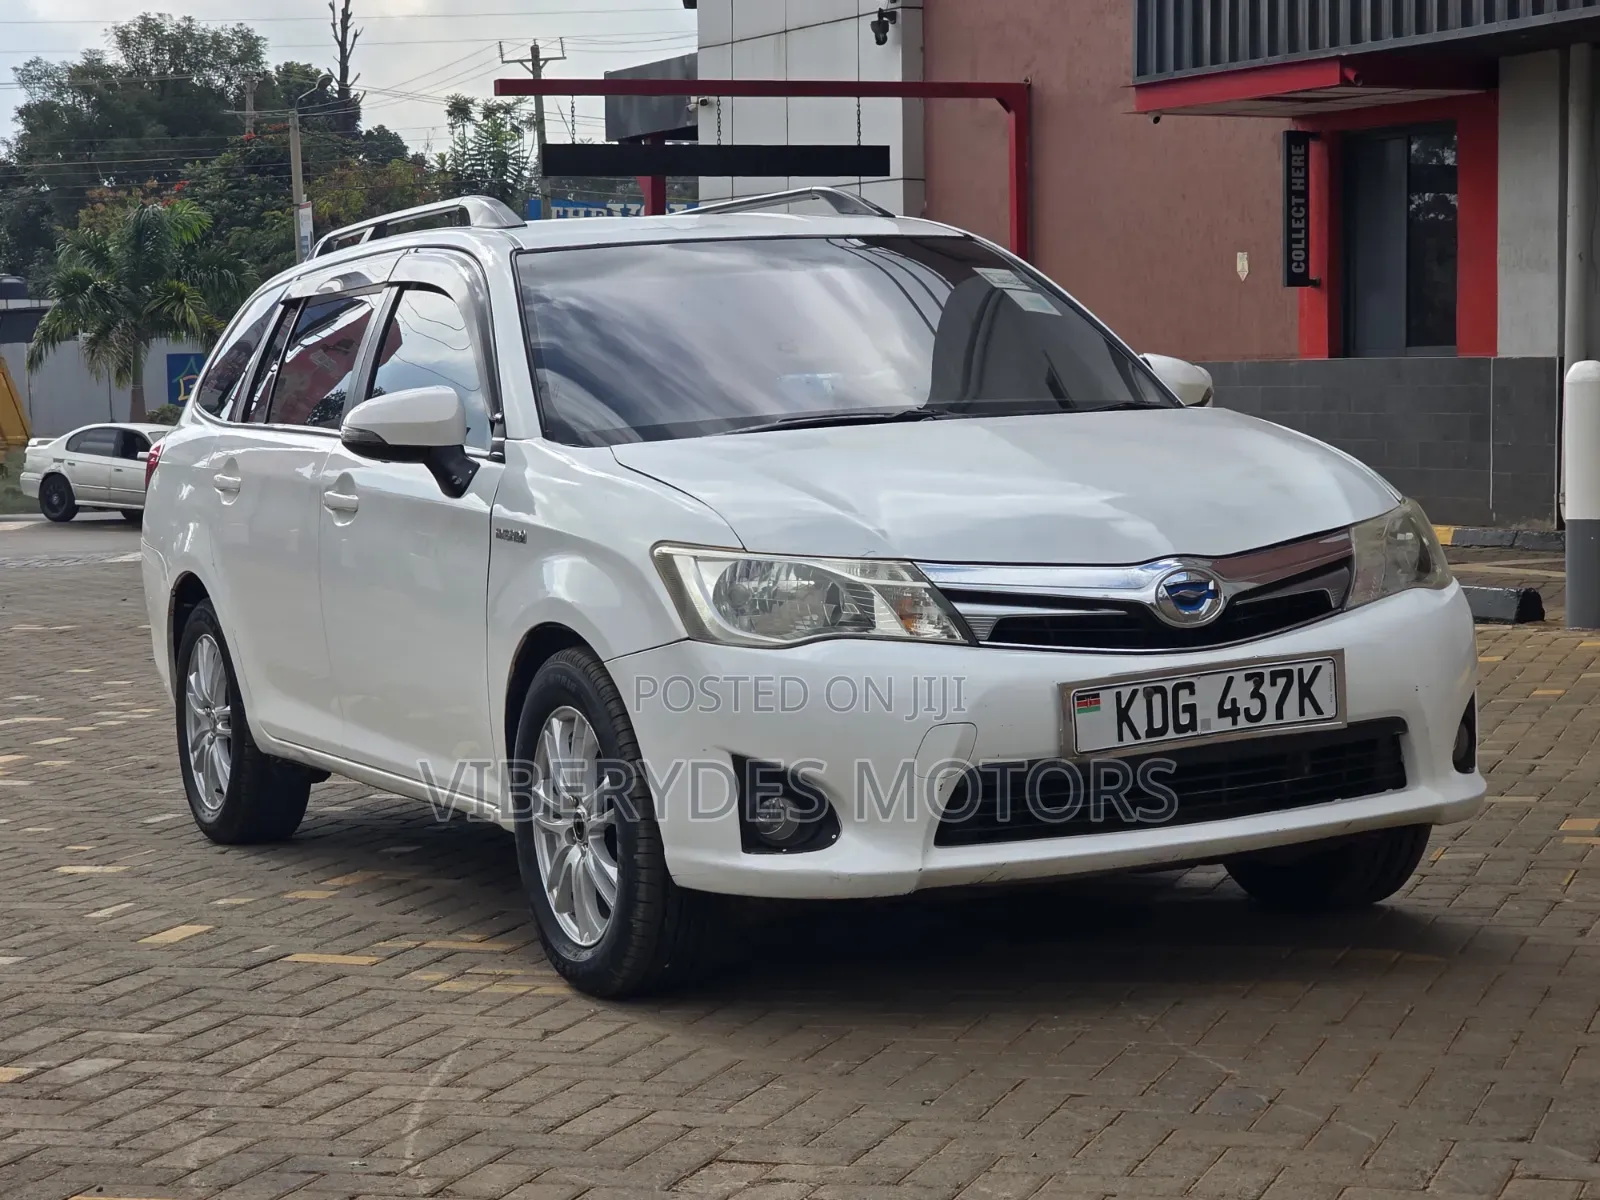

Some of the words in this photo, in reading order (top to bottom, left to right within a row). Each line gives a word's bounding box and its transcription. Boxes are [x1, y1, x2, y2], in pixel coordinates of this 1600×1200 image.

[1291, 144, 1306, 191] HERE
[1291, 196, 1306, 273] COLLECT
[1115, 681, 1198, 743] KDG
[1217, 665, 1325, 726] 437K
